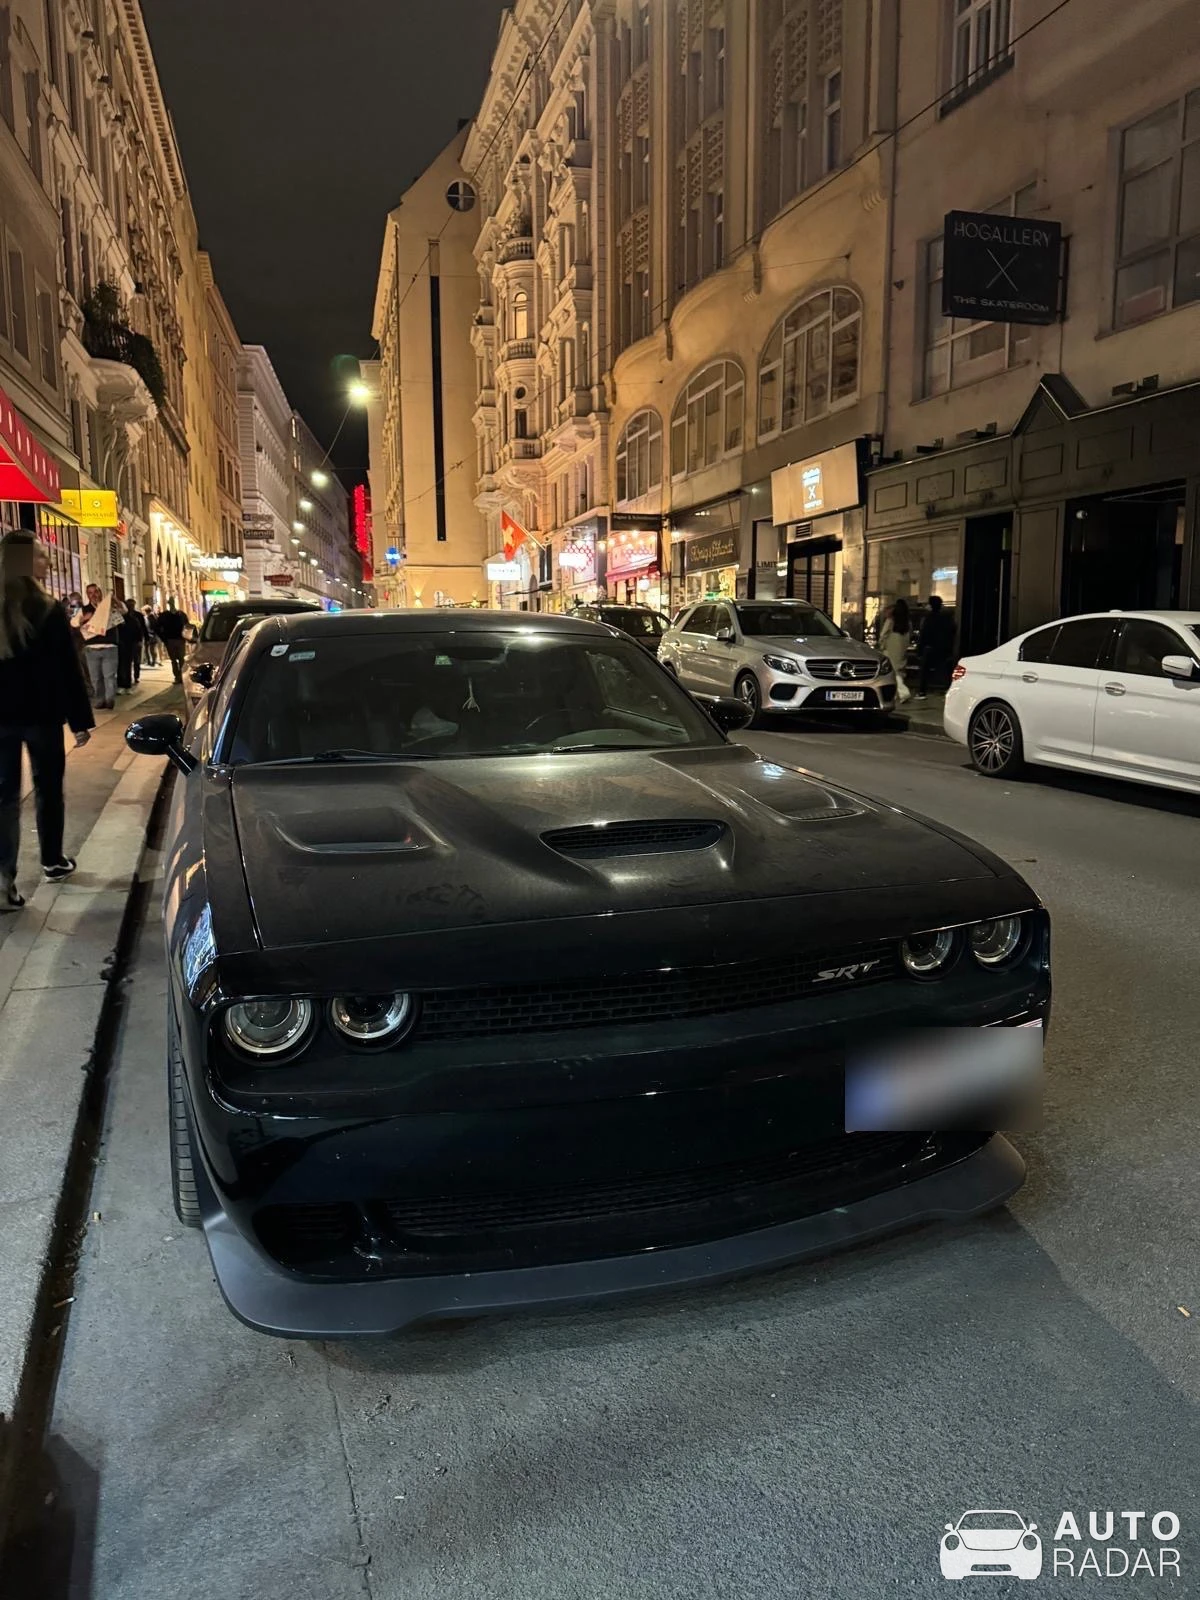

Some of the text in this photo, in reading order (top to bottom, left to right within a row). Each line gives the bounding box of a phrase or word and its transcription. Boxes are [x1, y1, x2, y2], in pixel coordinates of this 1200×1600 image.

[953, 221, 1051, 247] HOGALLERY
[953, 295, 1050, 313] THE SKATEROOM
[812, 960, 880, 982] SRT
